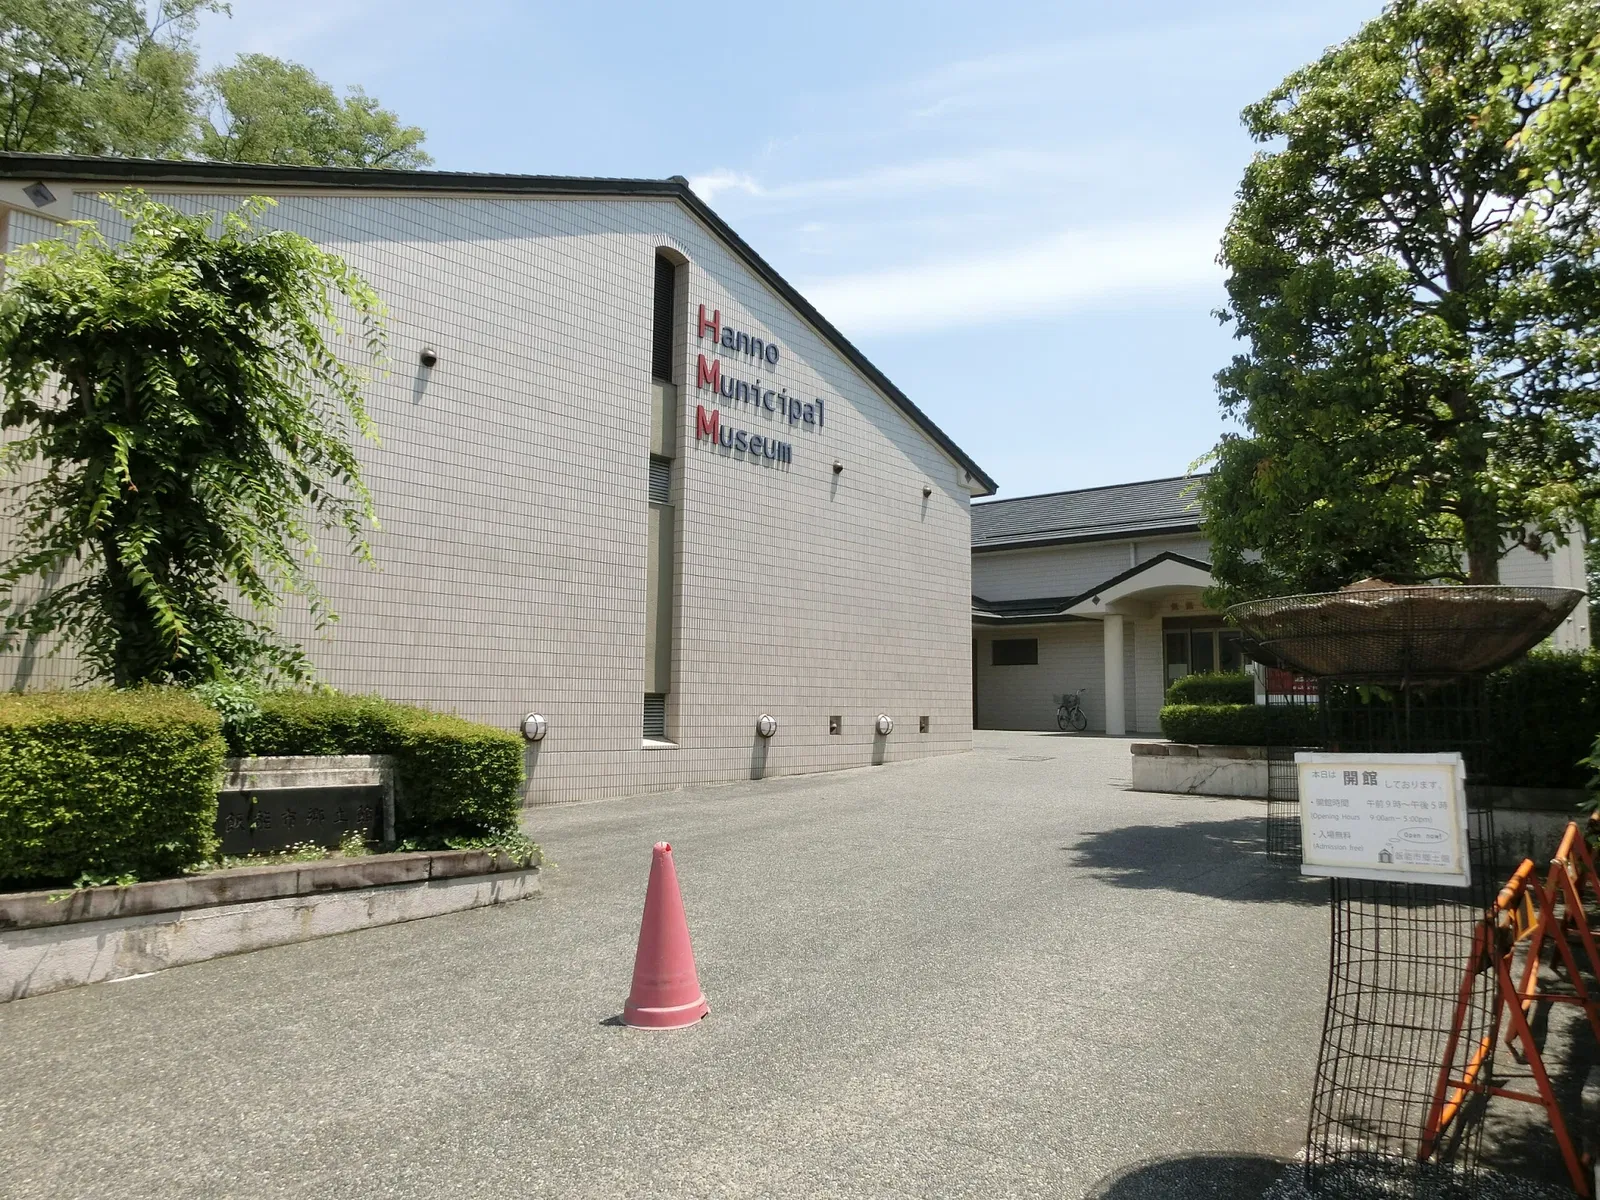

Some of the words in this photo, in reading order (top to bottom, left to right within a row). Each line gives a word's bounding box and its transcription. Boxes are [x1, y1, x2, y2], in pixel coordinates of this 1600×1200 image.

[699, 303, 780, 365] Hanno
[697, 353, 825, 427] Municipal
[696, 404, 793, 464] Museum
[1311, 770, 1336, 779] 本日は
[1343, 770, 1378, 786] 開館
[1341, 813, 1360, 821] Hours
[1403, 831, 1421, 839] Open
